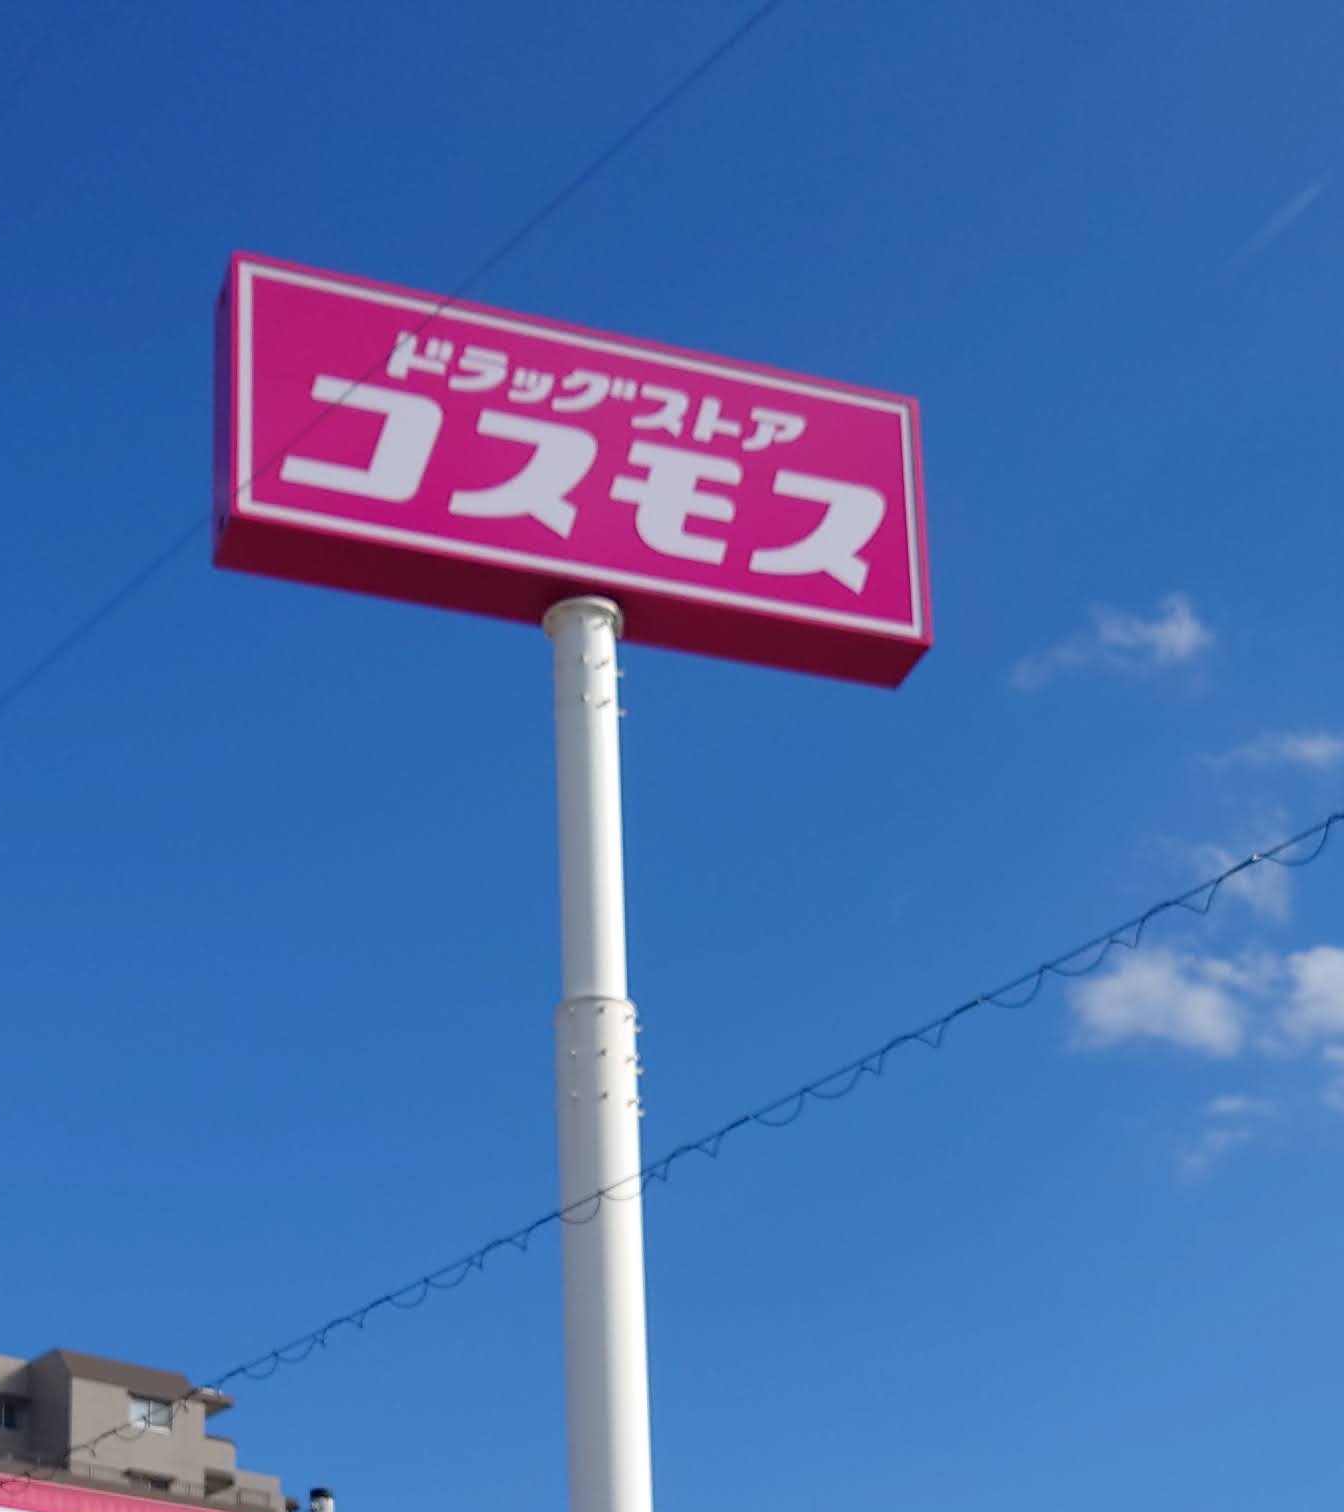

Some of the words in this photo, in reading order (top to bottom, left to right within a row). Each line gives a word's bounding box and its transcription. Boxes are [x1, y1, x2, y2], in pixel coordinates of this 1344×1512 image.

[386, 331, 806, 451] ドラッグストア
[279, 375, 886, 595] コスモス
